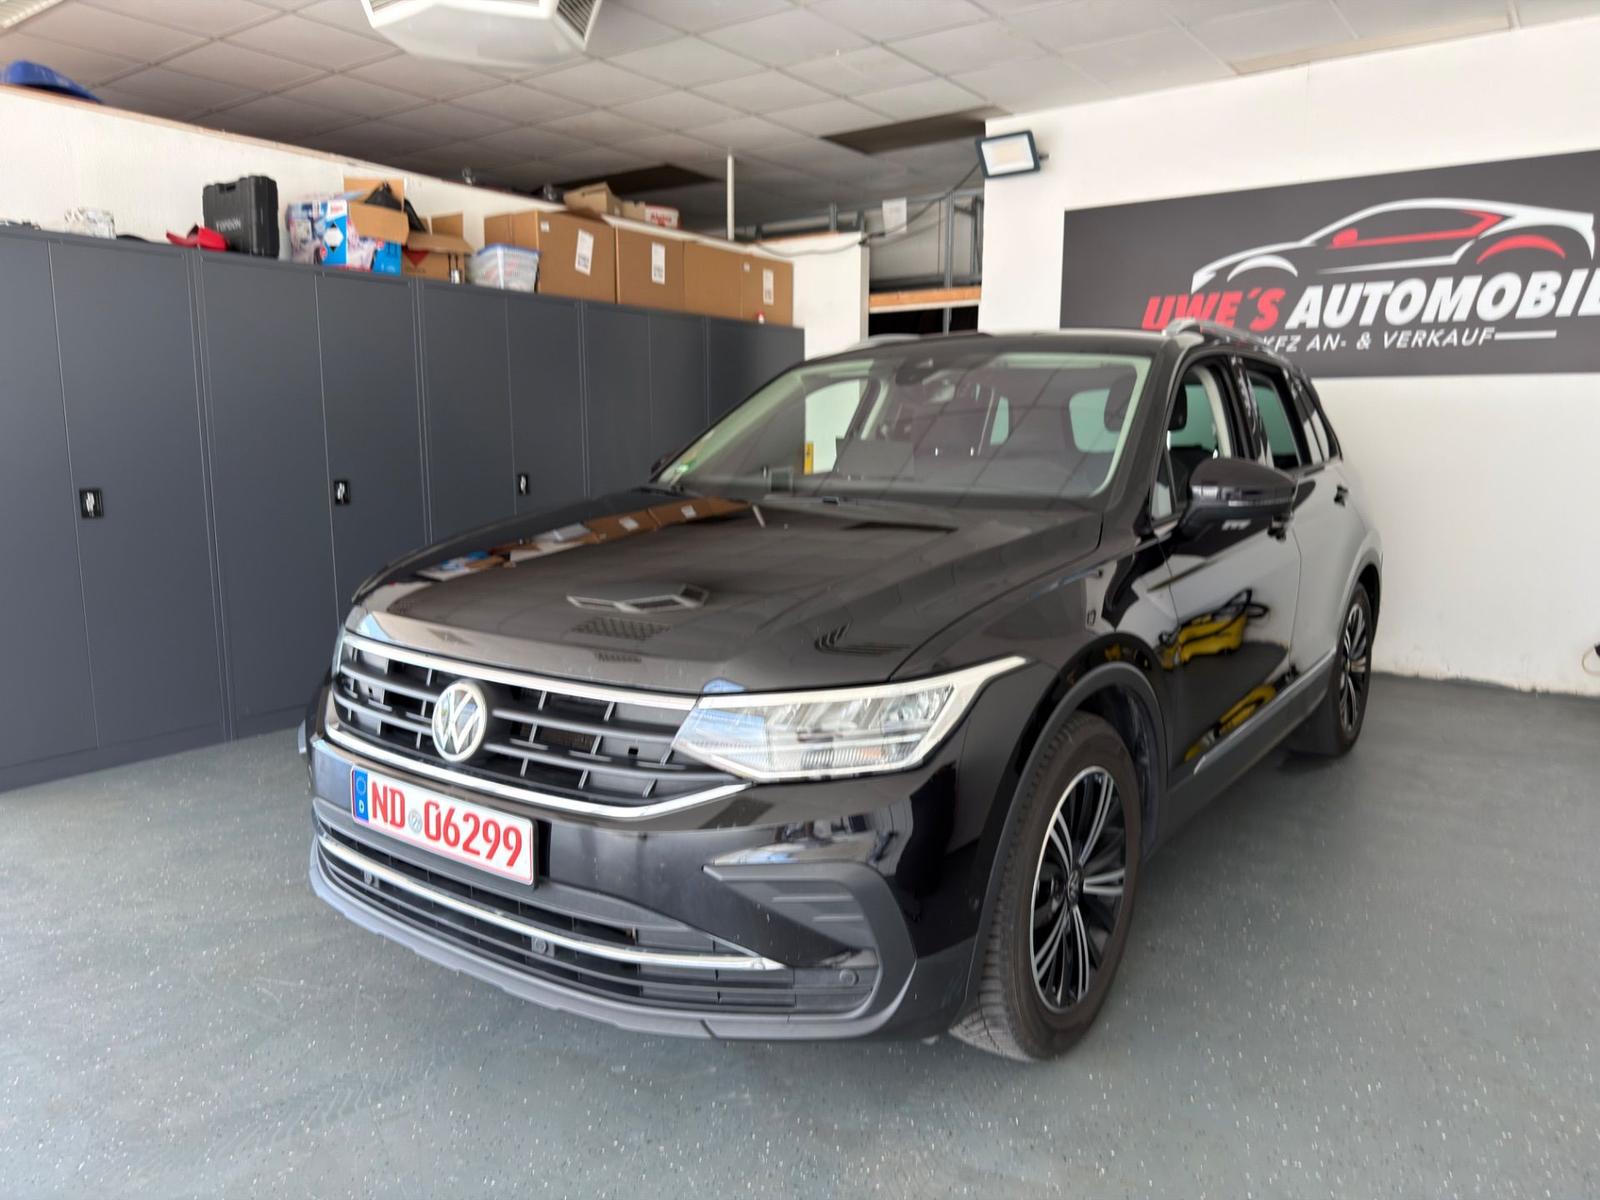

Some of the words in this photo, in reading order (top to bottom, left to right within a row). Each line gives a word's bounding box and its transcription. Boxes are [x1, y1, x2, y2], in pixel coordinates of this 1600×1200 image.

[1356, 331, 1371, 350] &
[1383, 326, 1495, 349] VERKAUF
[372, 781, 405, 828] ND
[424, 799, 523, 868] 06299
